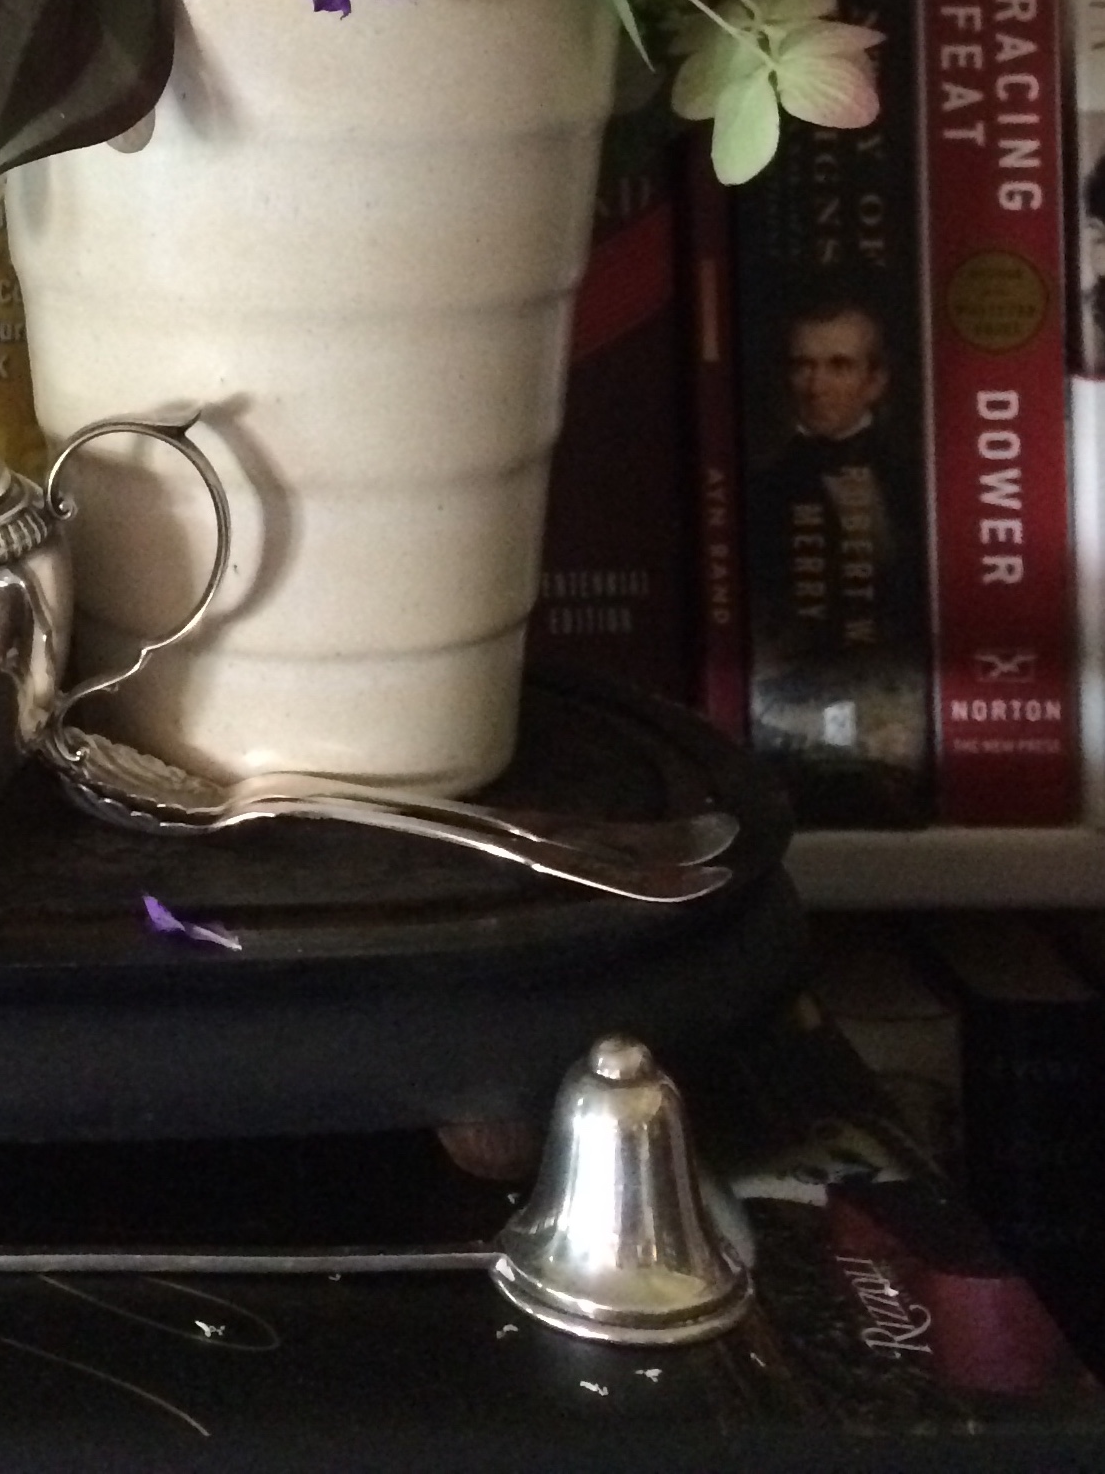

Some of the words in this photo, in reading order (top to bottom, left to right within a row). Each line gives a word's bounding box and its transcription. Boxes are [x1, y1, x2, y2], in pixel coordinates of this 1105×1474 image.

[705, 467, 727, 527] AYN
[839, 465, 876, 601] ROBERT
[974, 389, 1024, 586] DOWER
[708, 542, 731, 626] RAND
[790, 502, 827, 623] MERRY
[951, 698, 1062, 722] NORTON
